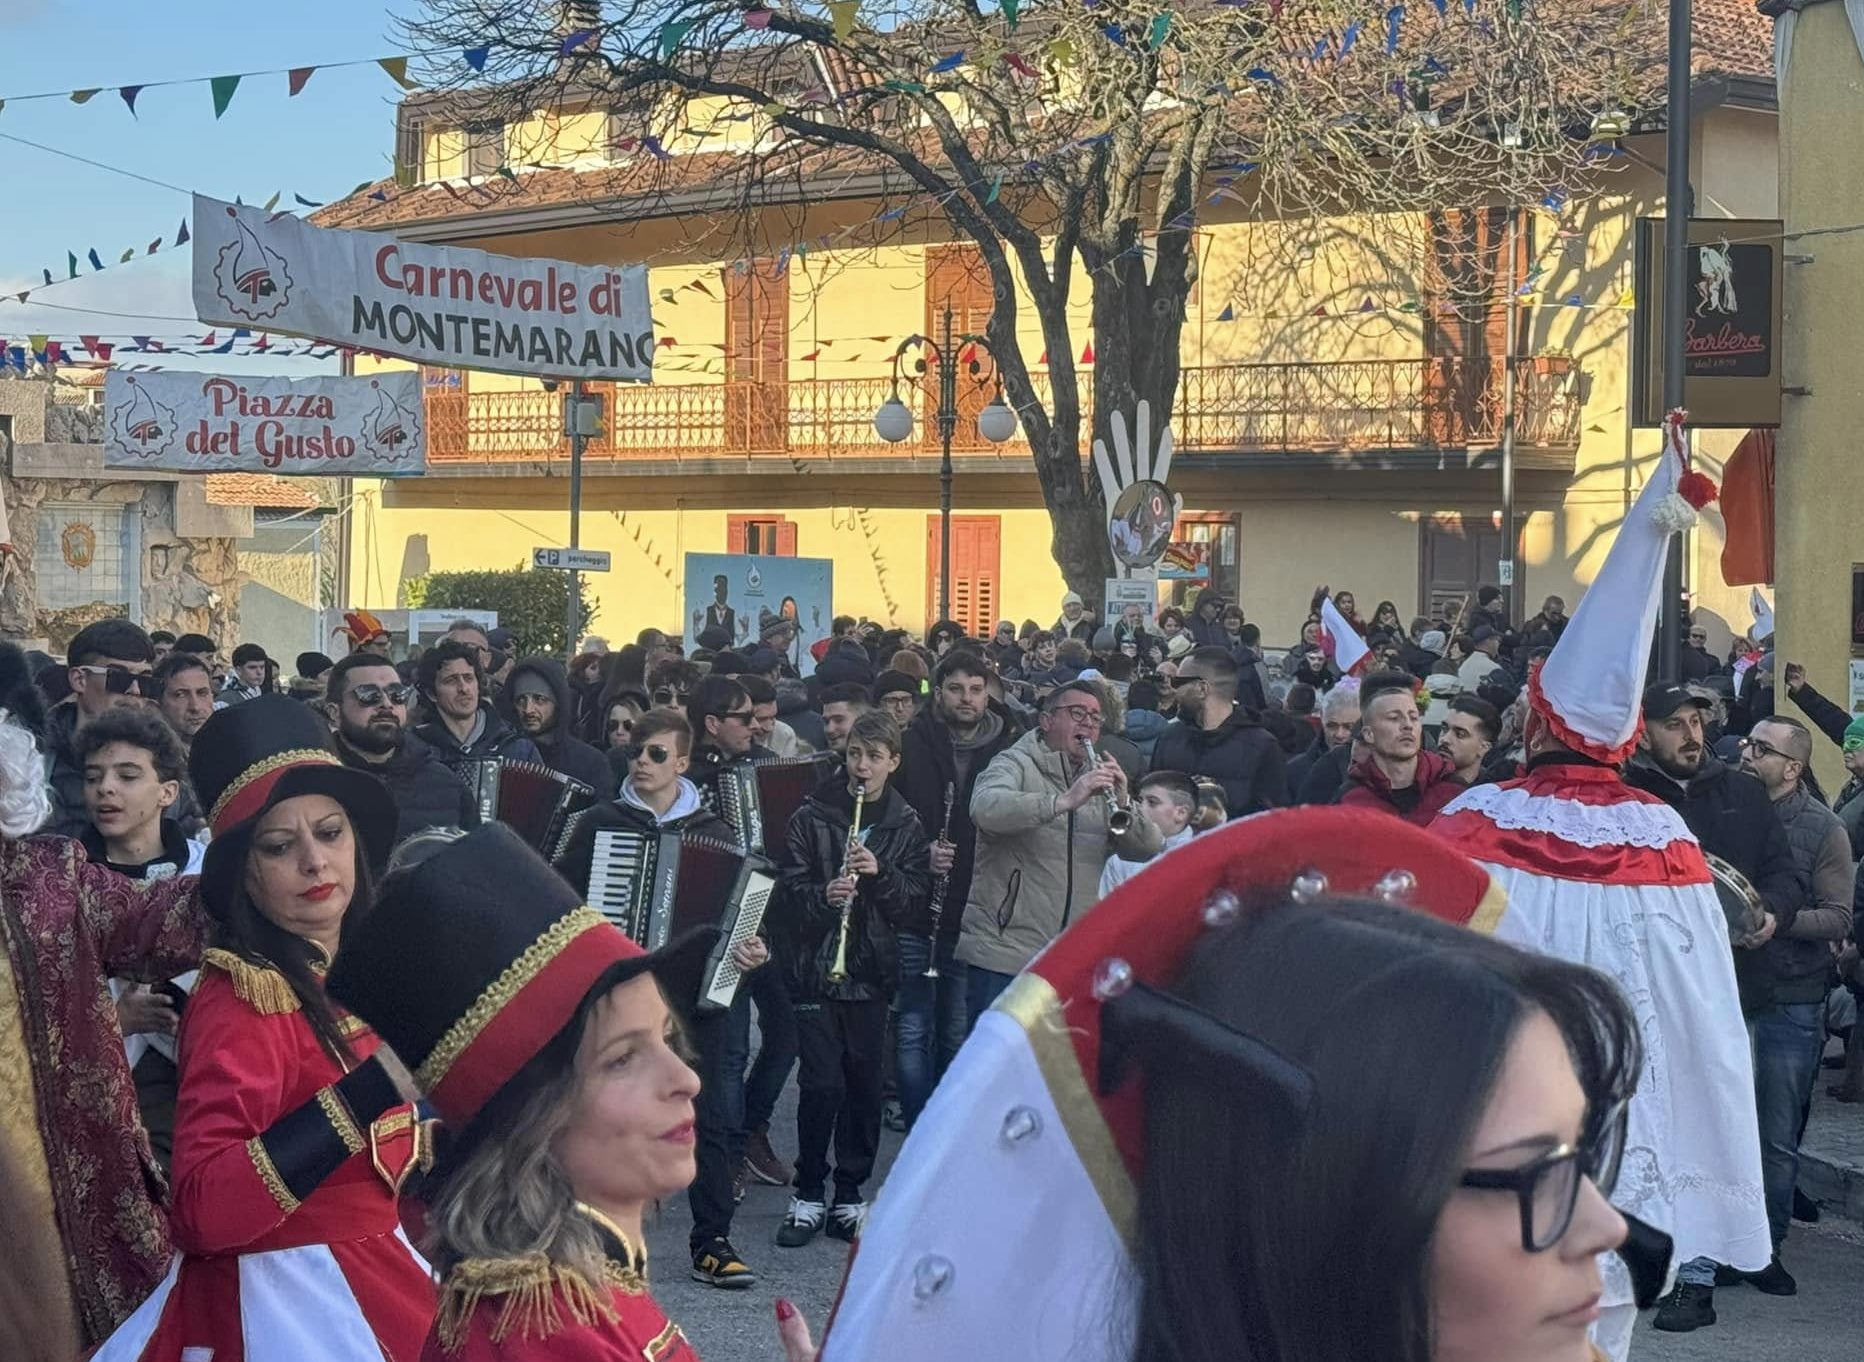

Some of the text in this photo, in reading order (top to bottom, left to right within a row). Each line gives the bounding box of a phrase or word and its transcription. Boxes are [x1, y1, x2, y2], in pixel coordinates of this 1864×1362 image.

[376, 245, 622, 318] Carnevale di
[203, 377, 336, 420] Piazza
[186, 419, 356, 468] del Gusto
